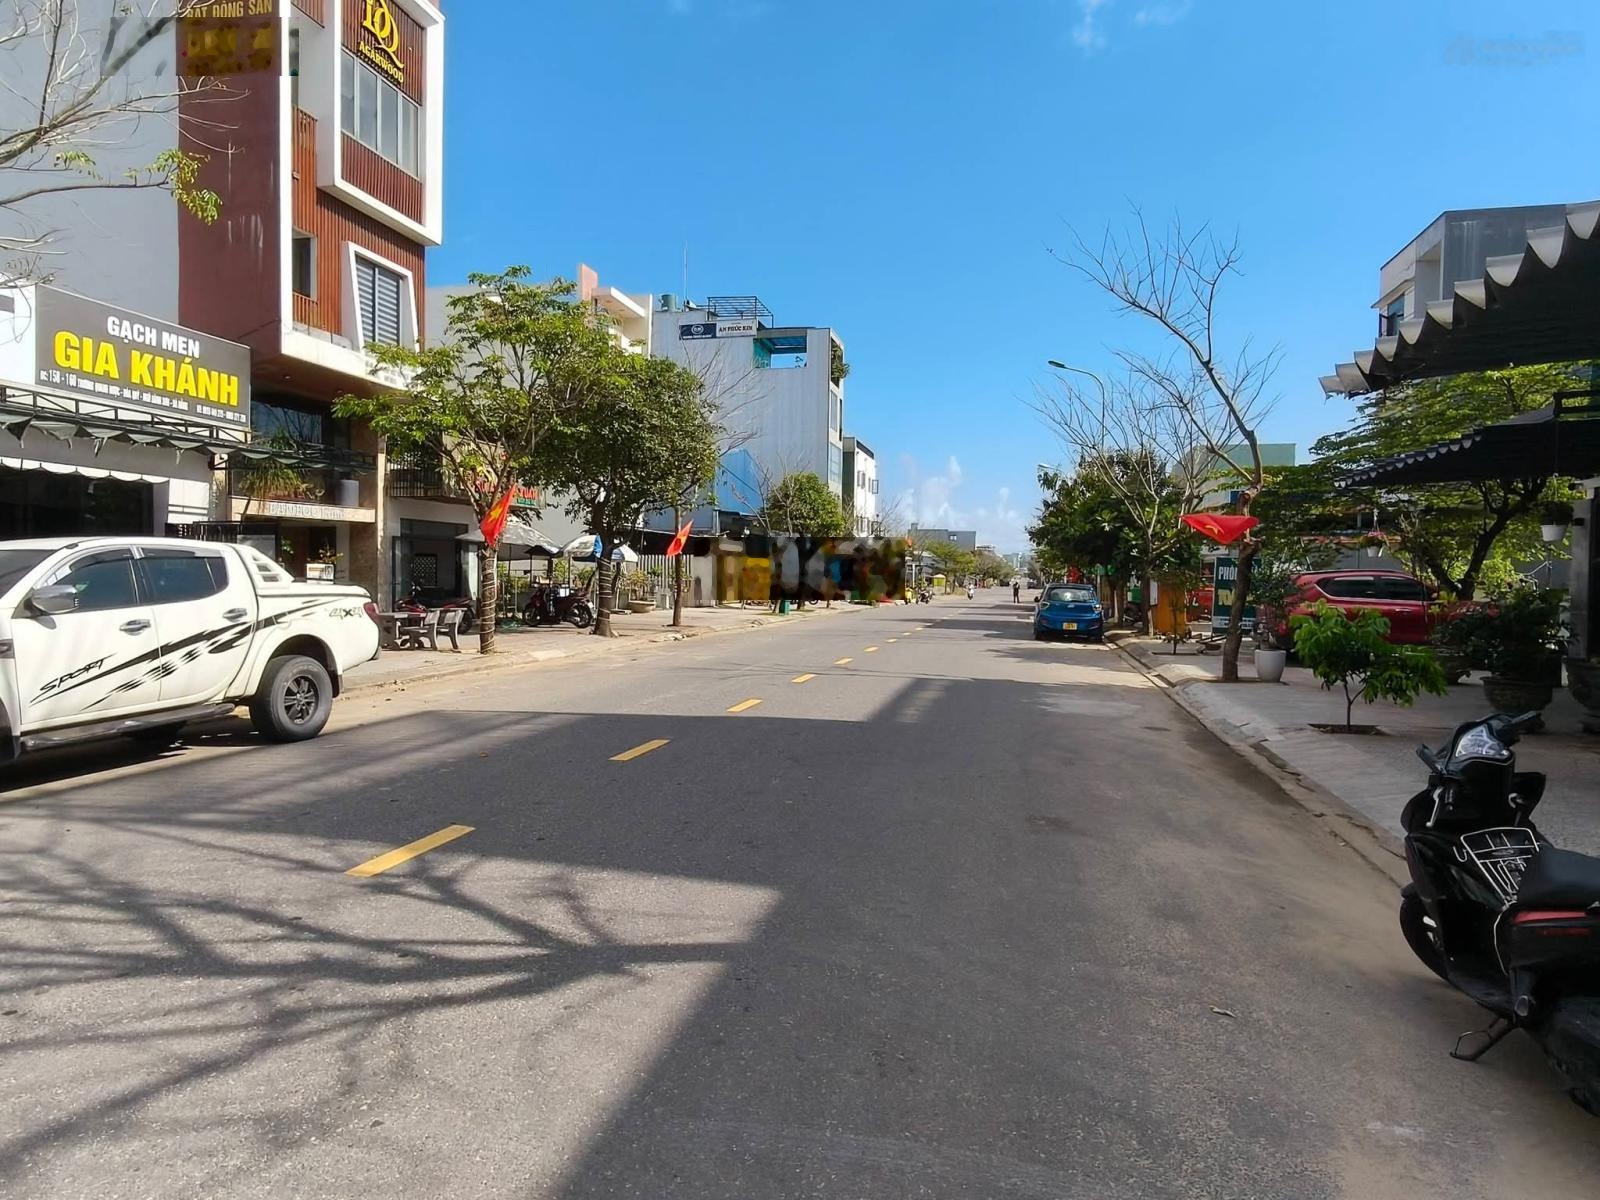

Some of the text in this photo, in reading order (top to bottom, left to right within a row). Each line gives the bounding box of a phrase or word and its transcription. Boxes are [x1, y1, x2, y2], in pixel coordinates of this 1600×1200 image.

[359, 40, 405, 84] AGARWOOD
[106, 315, 200, 359] GẠCH MEN
[54, 330, 120, 380] GIA
[130, 350, 240, 408] KHÁNH
[31, 653, 113, 702] SPORT
